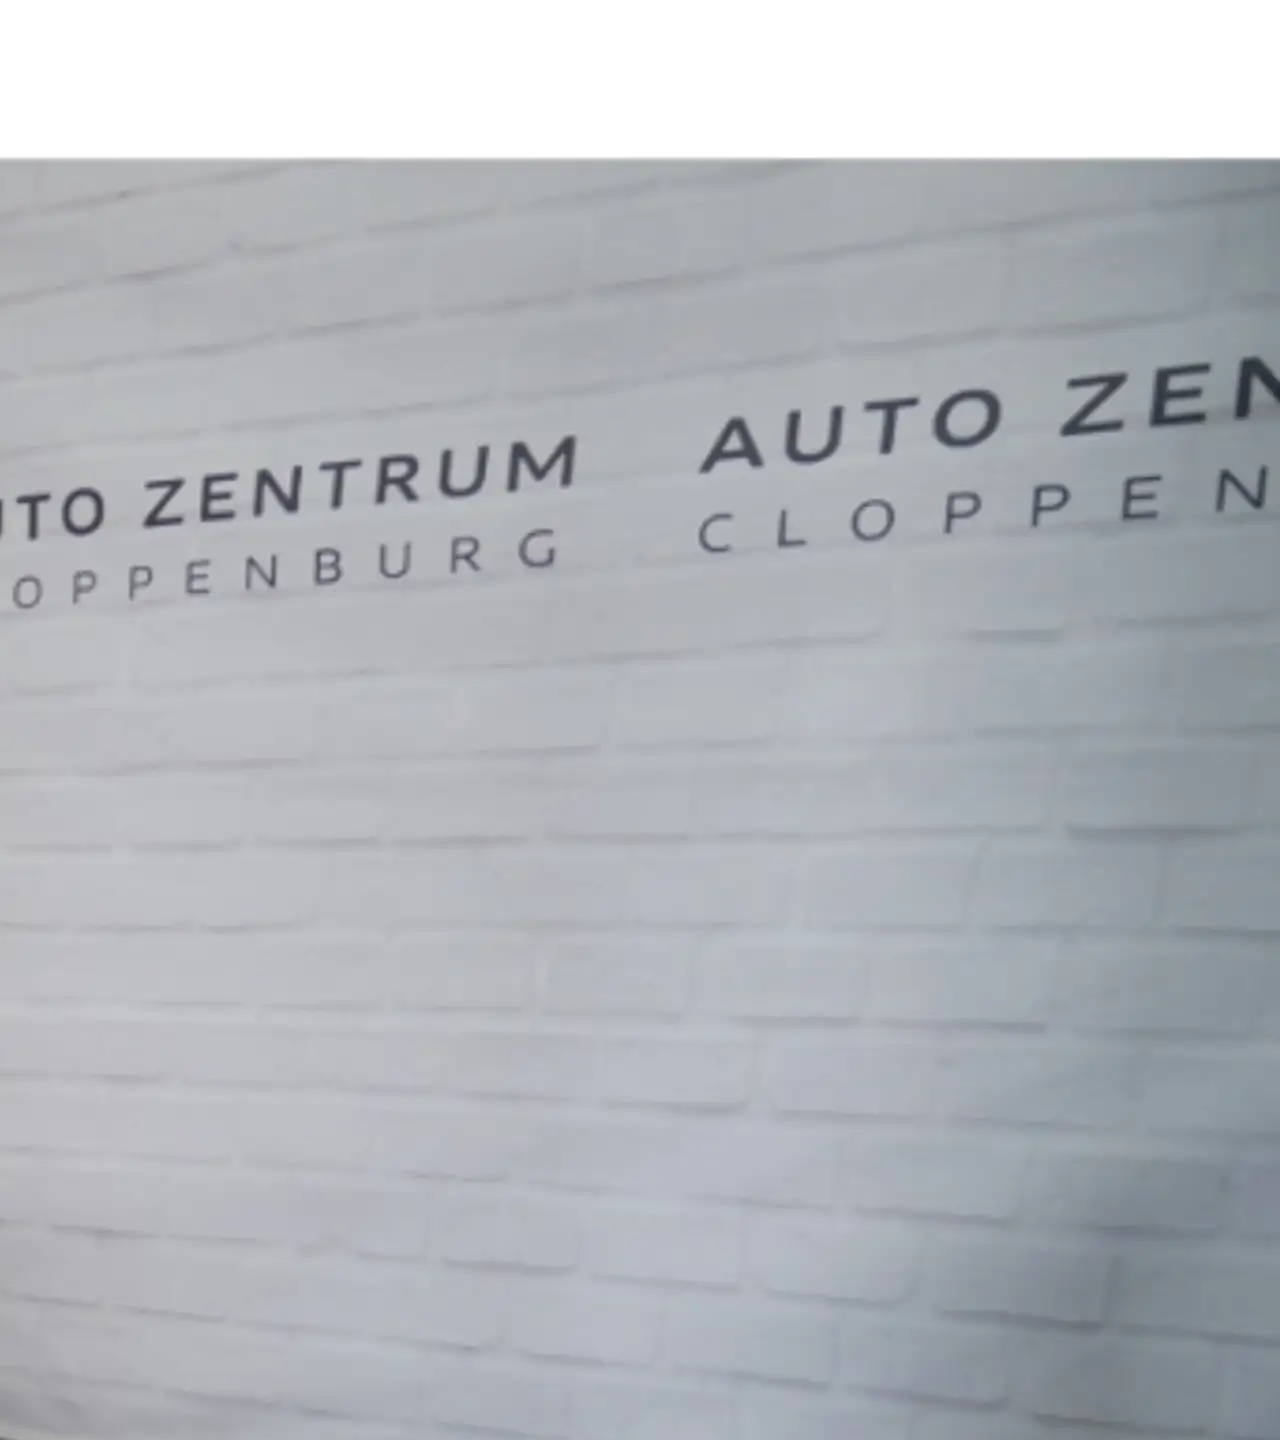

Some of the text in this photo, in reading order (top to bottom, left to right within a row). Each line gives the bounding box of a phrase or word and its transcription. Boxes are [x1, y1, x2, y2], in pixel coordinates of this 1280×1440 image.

[698, 388, 1004, 475] AUTO
[141, 434, 578, 530] ZENTRUM
[698, 463, 1270, 556] CLOPPEN
